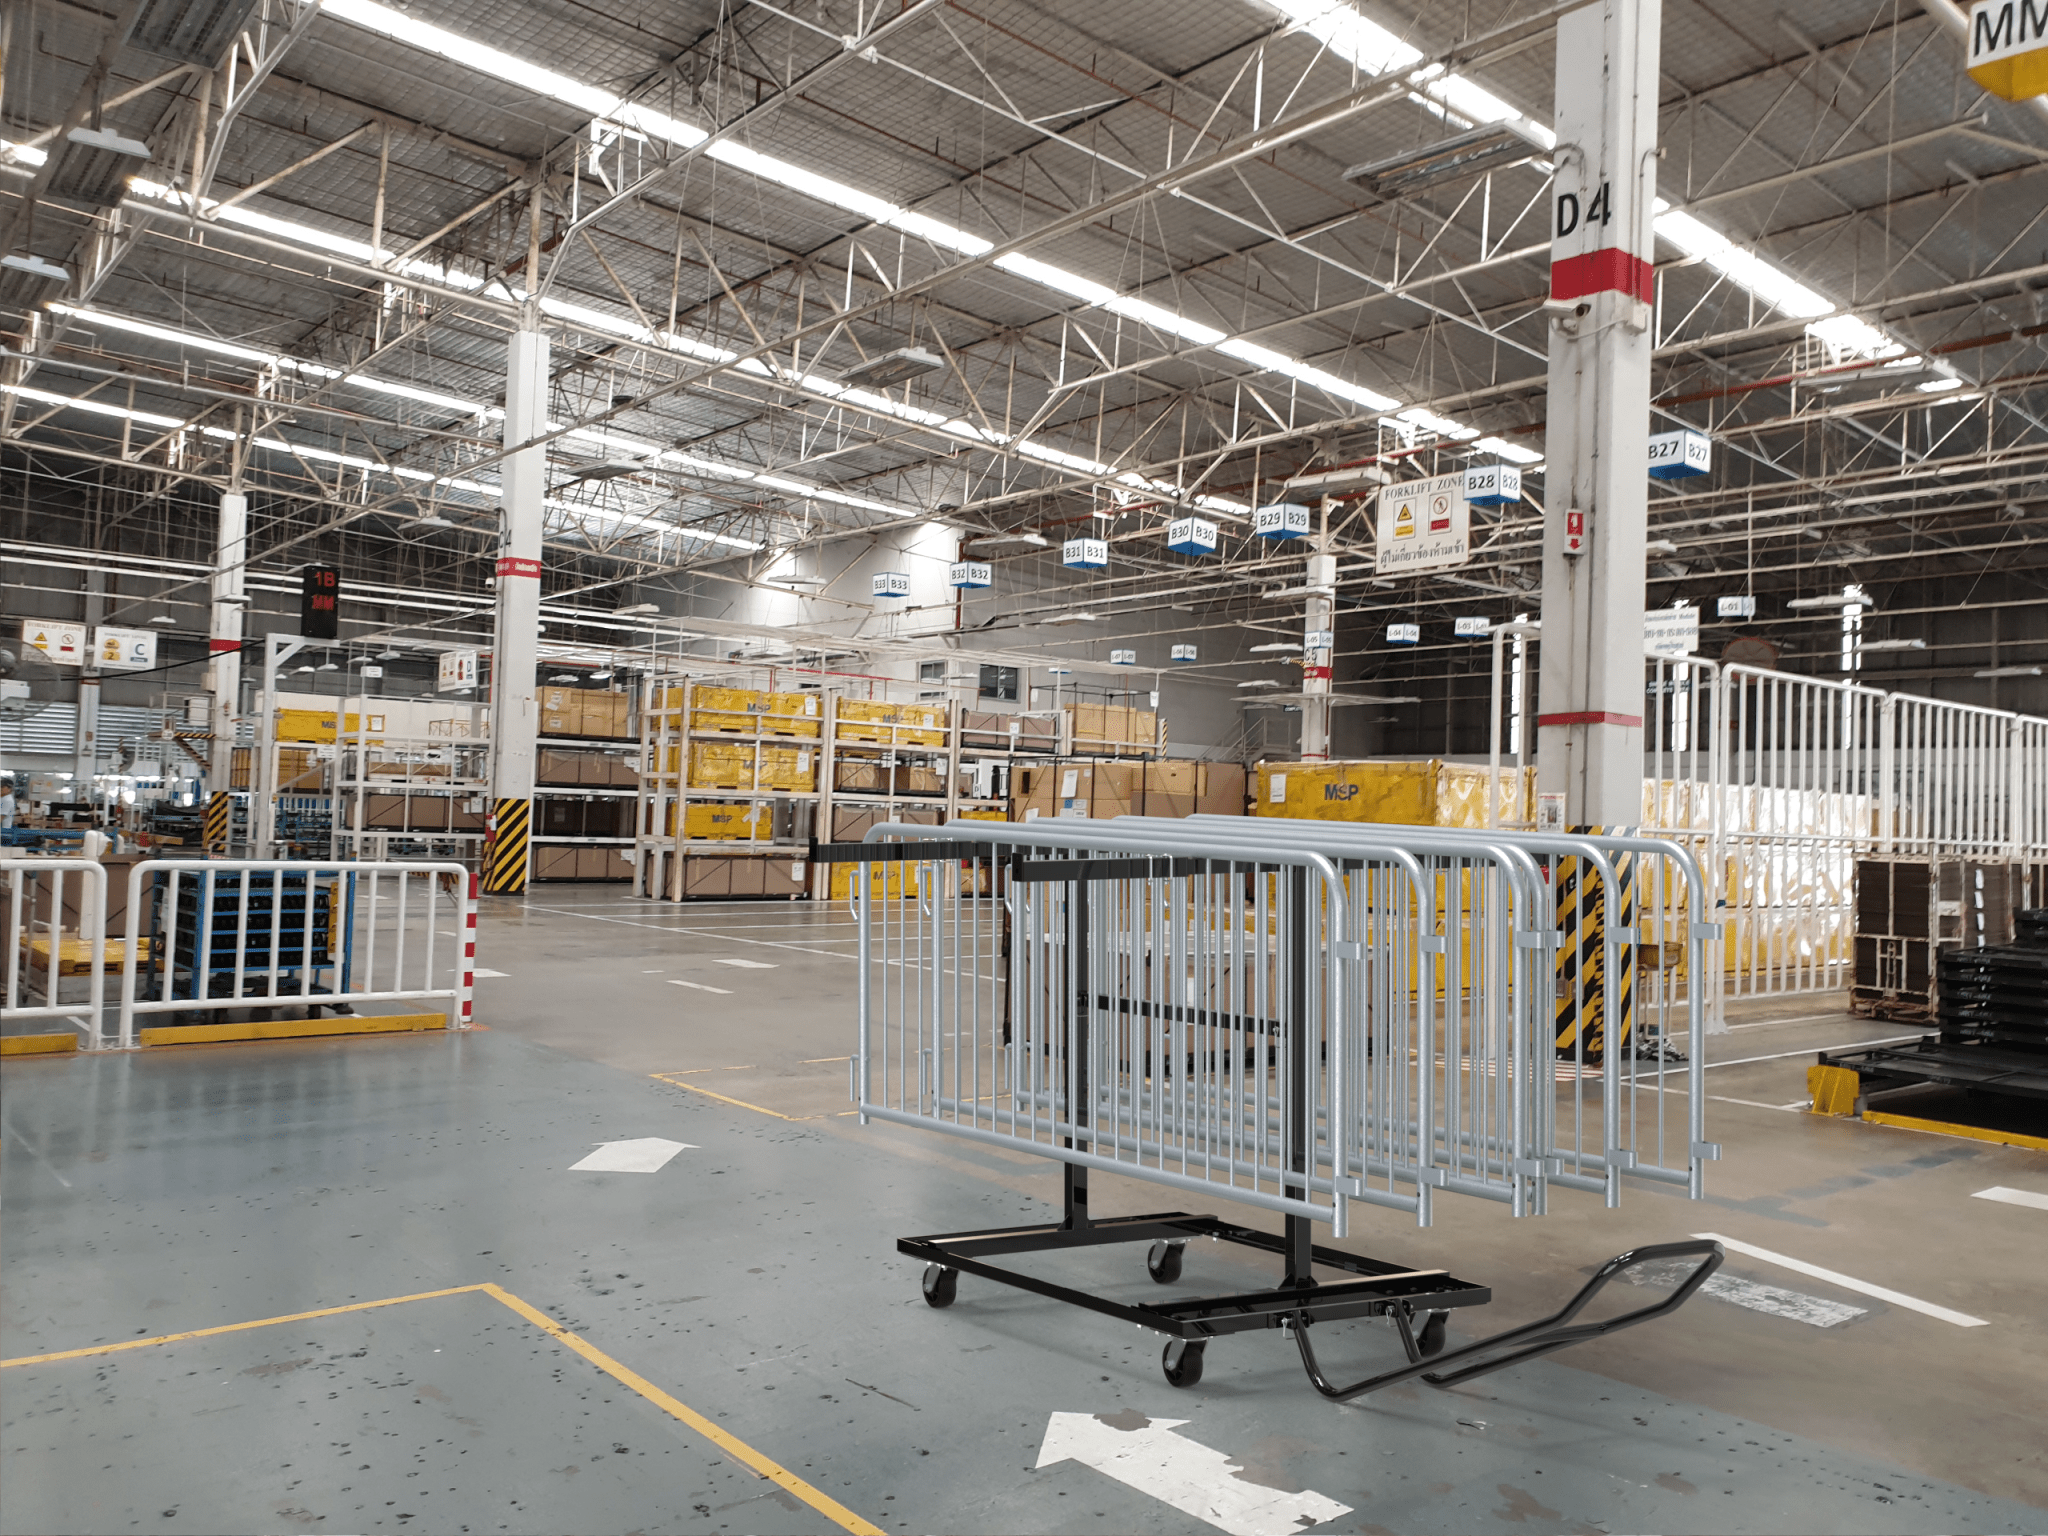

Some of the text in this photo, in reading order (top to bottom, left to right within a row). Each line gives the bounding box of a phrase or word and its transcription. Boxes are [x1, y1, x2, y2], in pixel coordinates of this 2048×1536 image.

[1648, 440, 1679, 459] B27
[1689, 443, 1707, 461] B27
[1385, 475, 1464, 500] FORKLIFT ZONE
[1468, 474, 1495, 490] B28
[1502, 474, 1518, 491] B28
[1260, 512, 1280, 526] B29
[1288, 512, 1306, 526] B29
[1171, 525, 1189, 539] B30
[1195, 526, 1214, 541] B30
[1065, 546, 1081, 558] B31
[1087, 546, 1104, 558] B31
[951, 569, 966, 580] B32
[971, 568, 988, 580] B32
[874, 580, 886, 590] B33
[891, 579, 907, 590] B33
[135, 643, 145, 656] C
[747, 702, 771, 713] MSP
[321, 720, 336, 729] MS
[1324, 783, 1359, 801] MSP
[712, 814, 732, 824] MSP
[873, 870, 896, 881] MP
